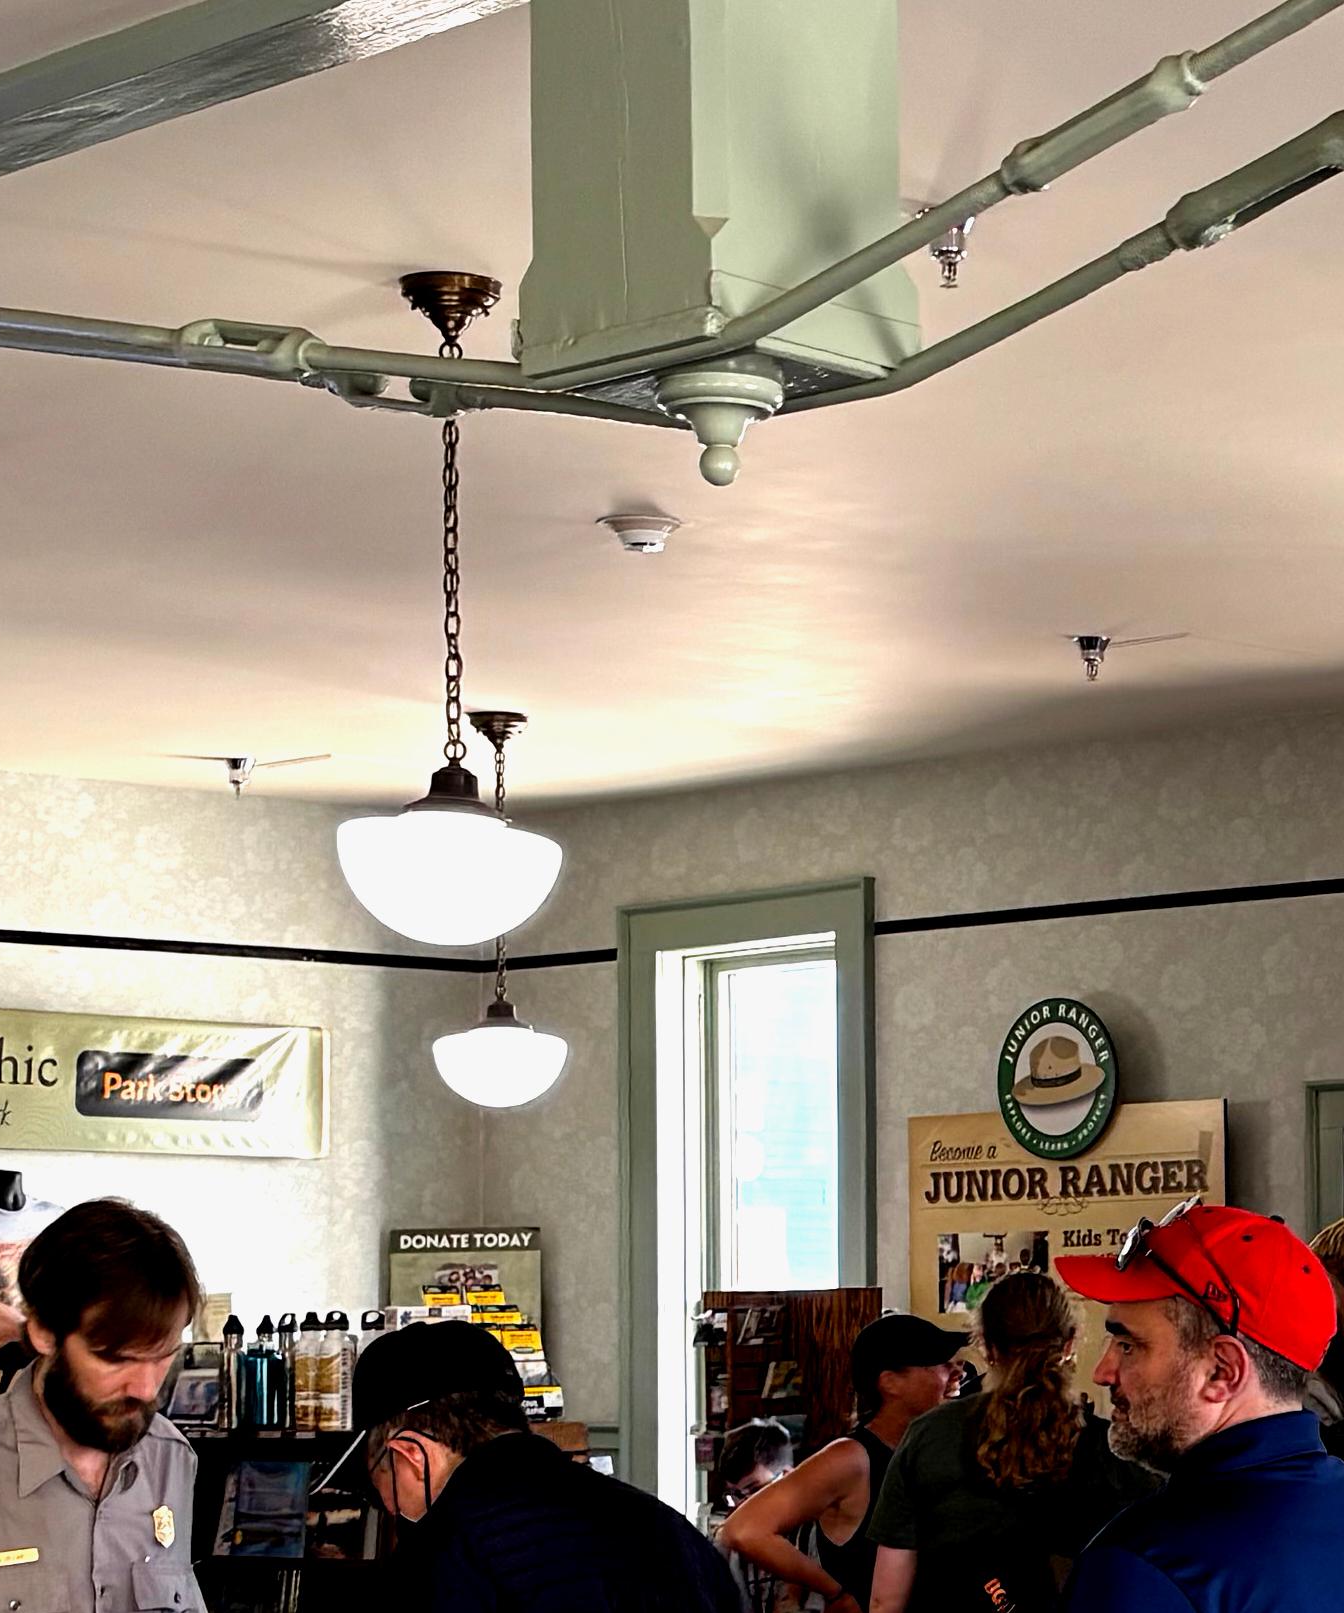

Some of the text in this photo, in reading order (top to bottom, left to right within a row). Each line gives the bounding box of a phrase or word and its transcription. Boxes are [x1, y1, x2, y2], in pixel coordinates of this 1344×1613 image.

[1005, 1003, 1110, 1064] JUNIOR RANGER
[102, 1071, 161, 1104] Park
[929, 1140, 998, 1162] Become a
[924, 1158, 1209, 1205] JUNIOR RANGER
[399, 1232, 533, 1250] DONATE TODAY
[1062, 1228, 1102, 1248] Kids
